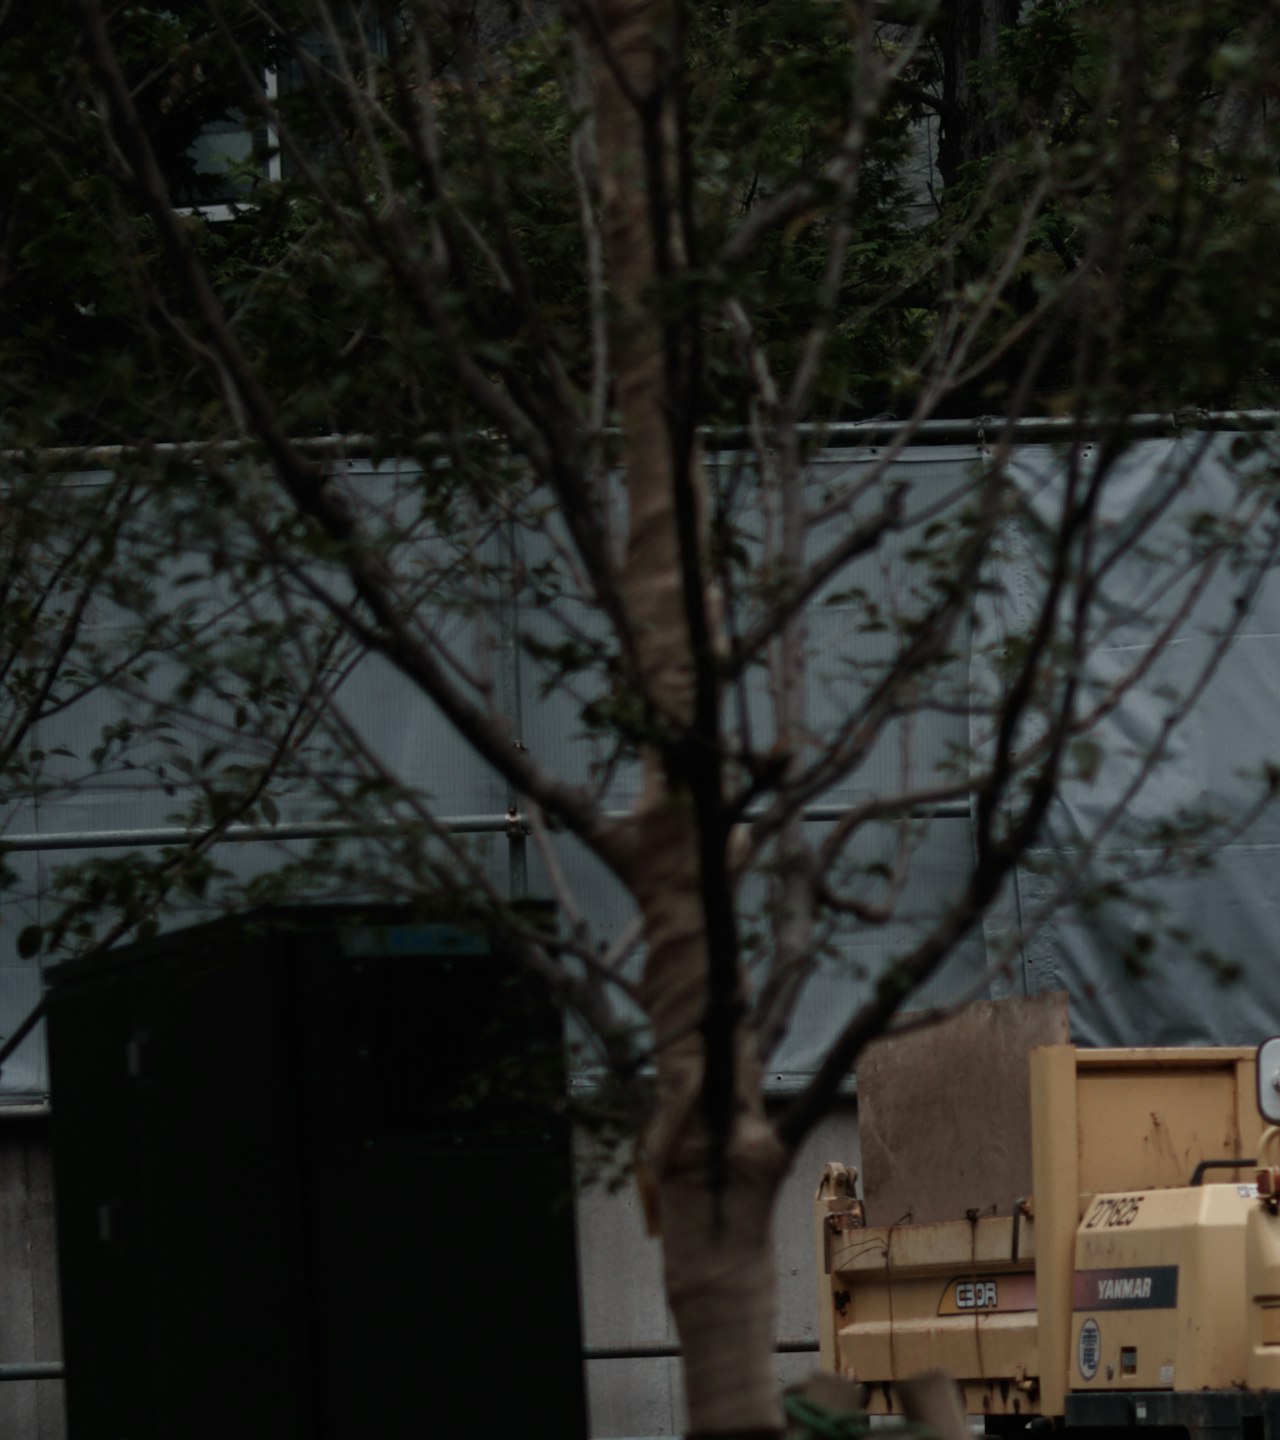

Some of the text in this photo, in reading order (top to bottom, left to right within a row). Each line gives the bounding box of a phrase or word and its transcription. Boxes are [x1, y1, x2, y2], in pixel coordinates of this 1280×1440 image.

[1085, 1196, 1145, 1229] 271825
[955, 1279, 998, 1309] C30R
[1097, 1276, 1152, 1301] YANMAR
